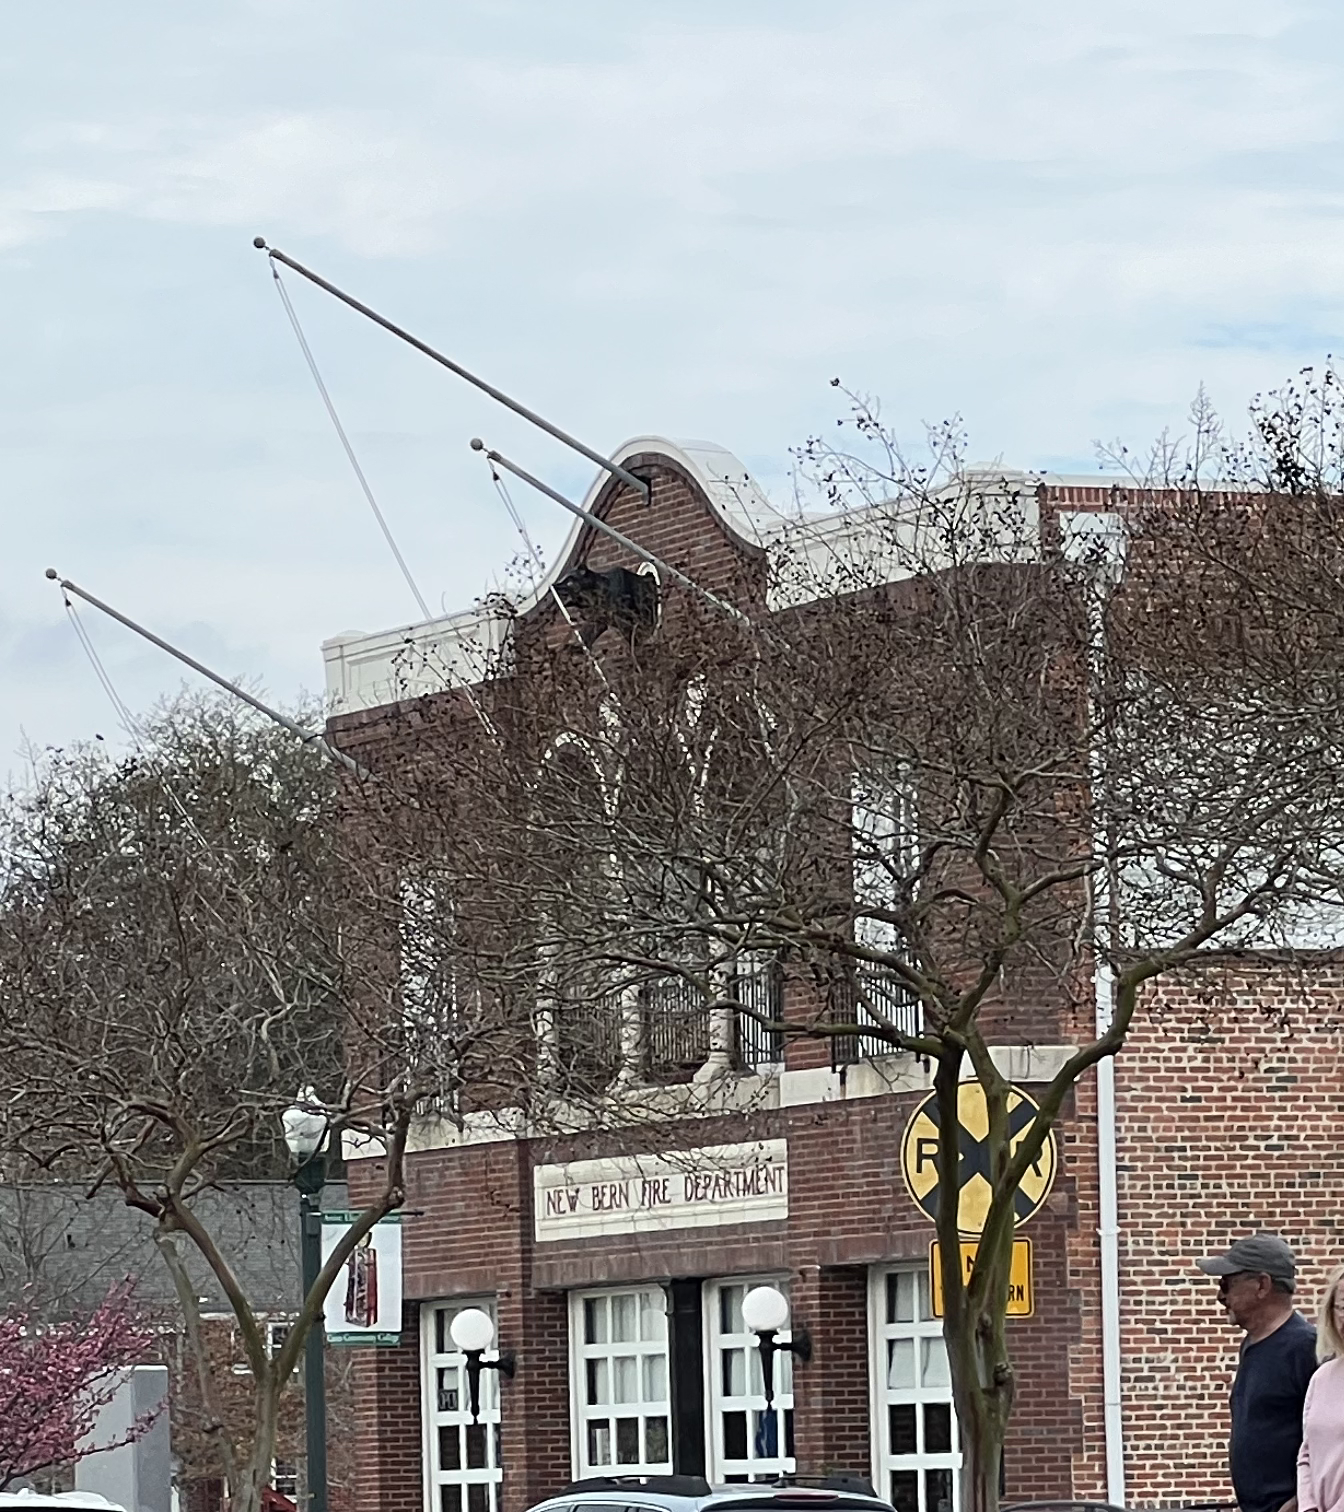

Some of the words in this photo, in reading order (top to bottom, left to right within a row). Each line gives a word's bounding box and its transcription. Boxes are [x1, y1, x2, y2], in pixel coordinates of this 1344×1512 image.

[546, 1188, 579, 1215] NEW
[592, 1181, 630, 1210] BERN
[641, 1178, 671, 1207] FIRE
[684, 1165, 785, 1203] DEPARTMENT
